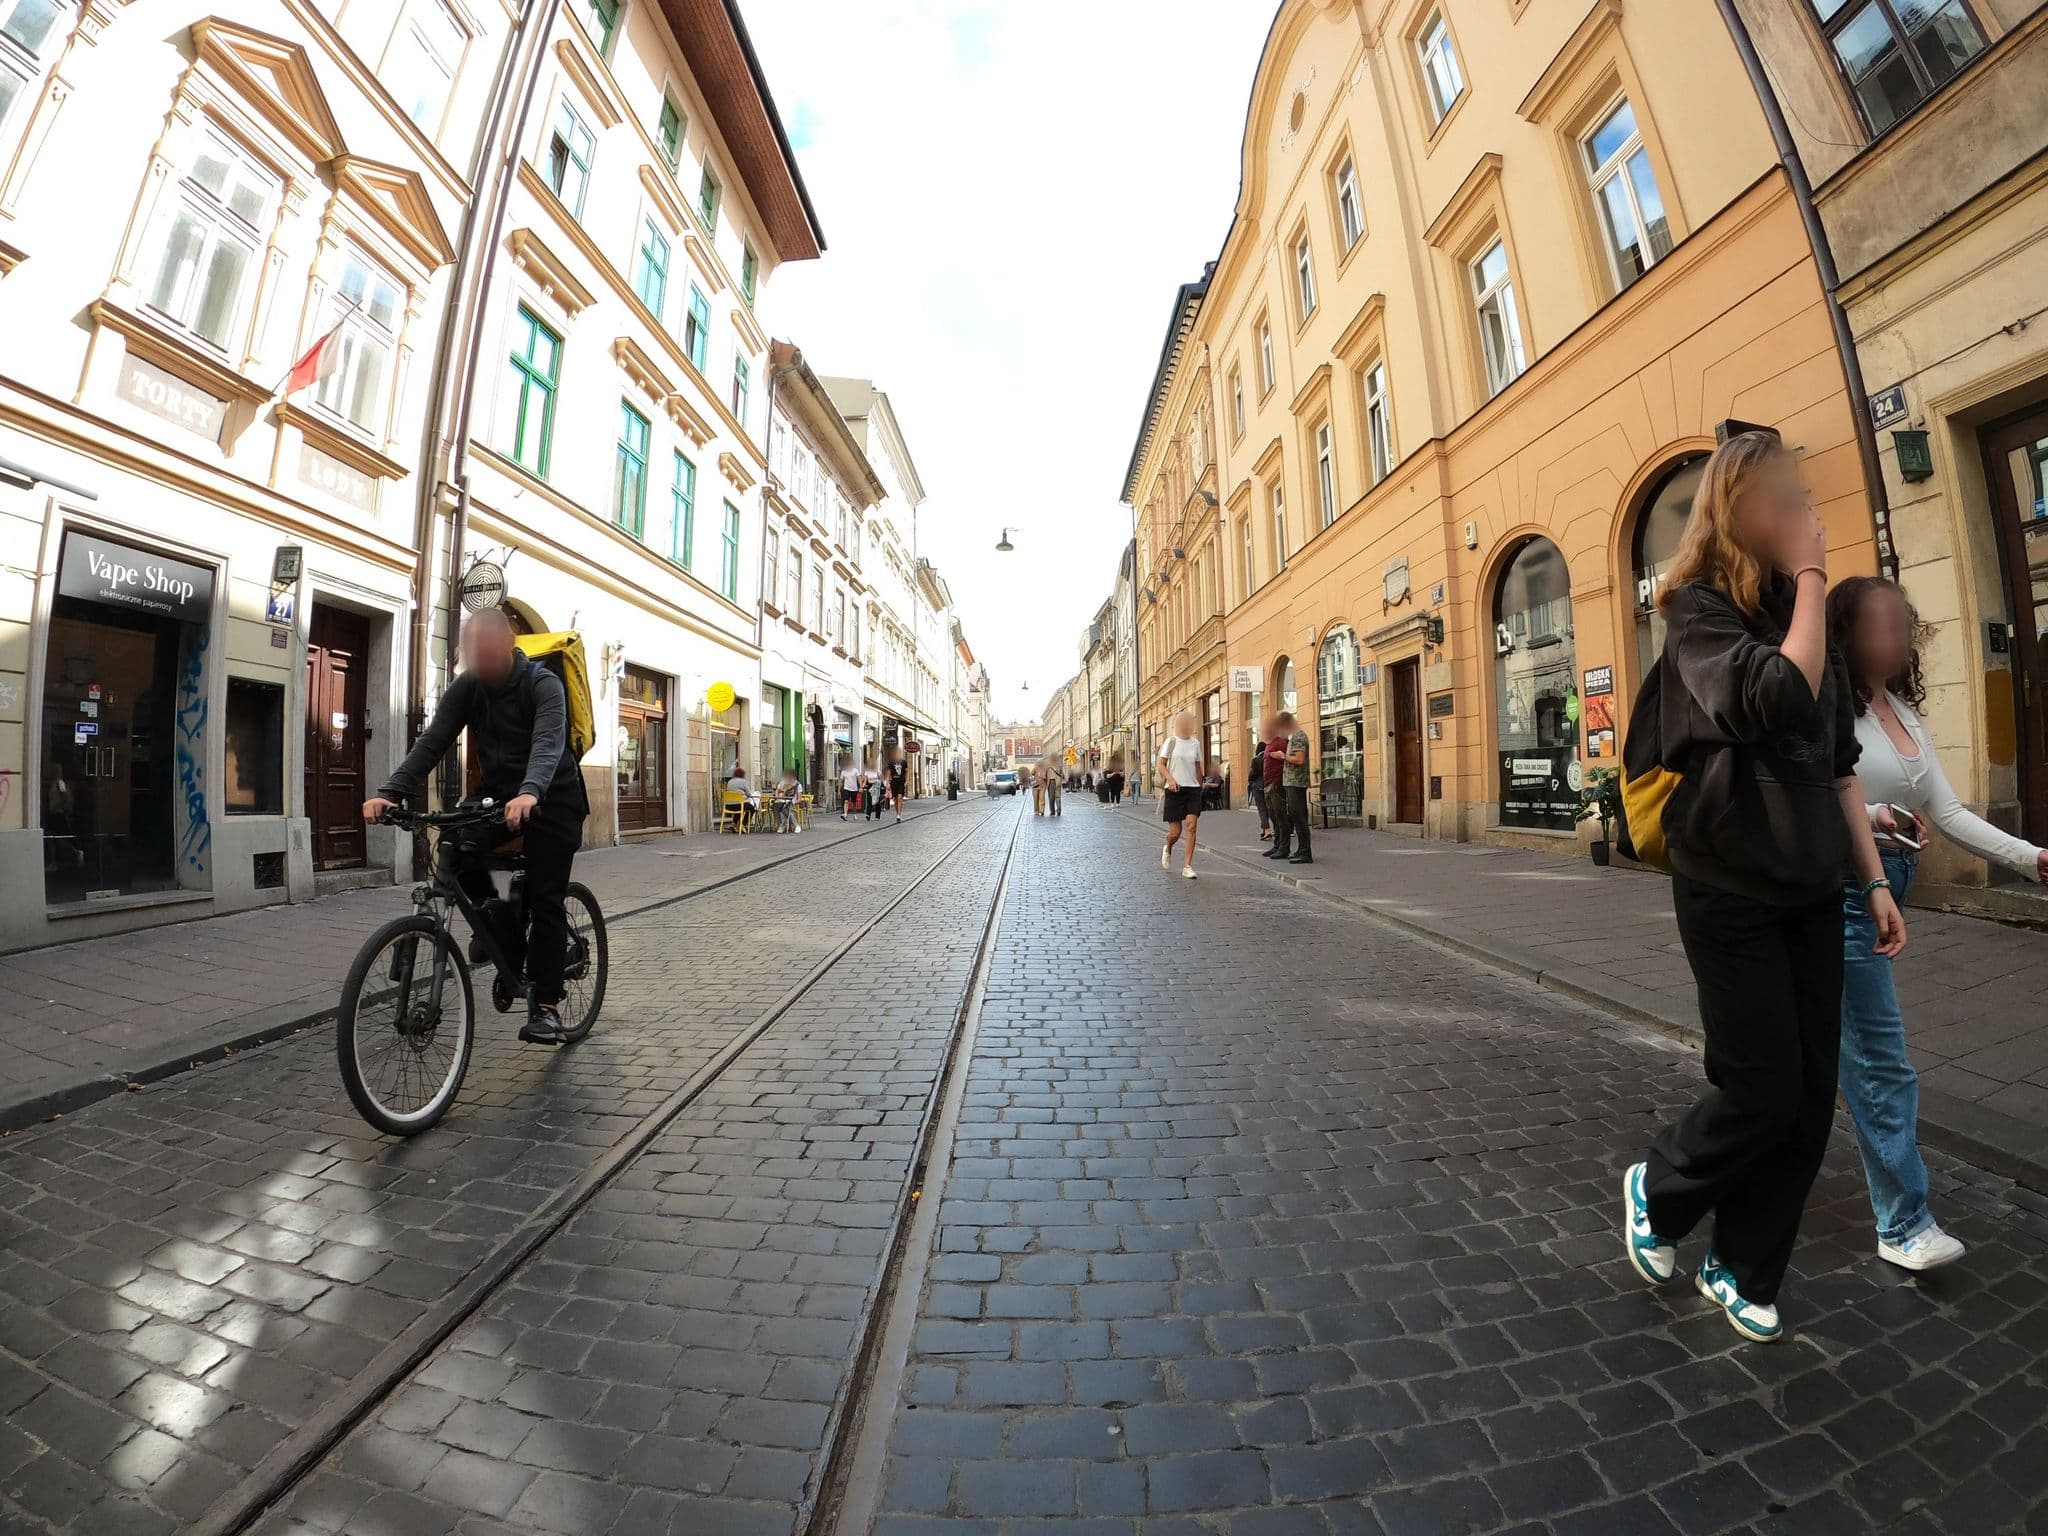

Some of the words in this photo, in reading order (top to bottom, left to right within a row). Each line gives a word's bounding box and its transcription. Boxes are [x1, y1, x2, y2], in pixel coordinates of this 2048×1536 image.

[131, 370, 214, 428] TORTY
[1875, 398, 1894, 418] 24
[88, 550, 139, 590] Vape
[143, 565, 194, 605] Shop
[99, 588, 142, 606] elektroniczne
[142, 599, 173, 613] papierosy
[275, 601, 289, 617] 27
